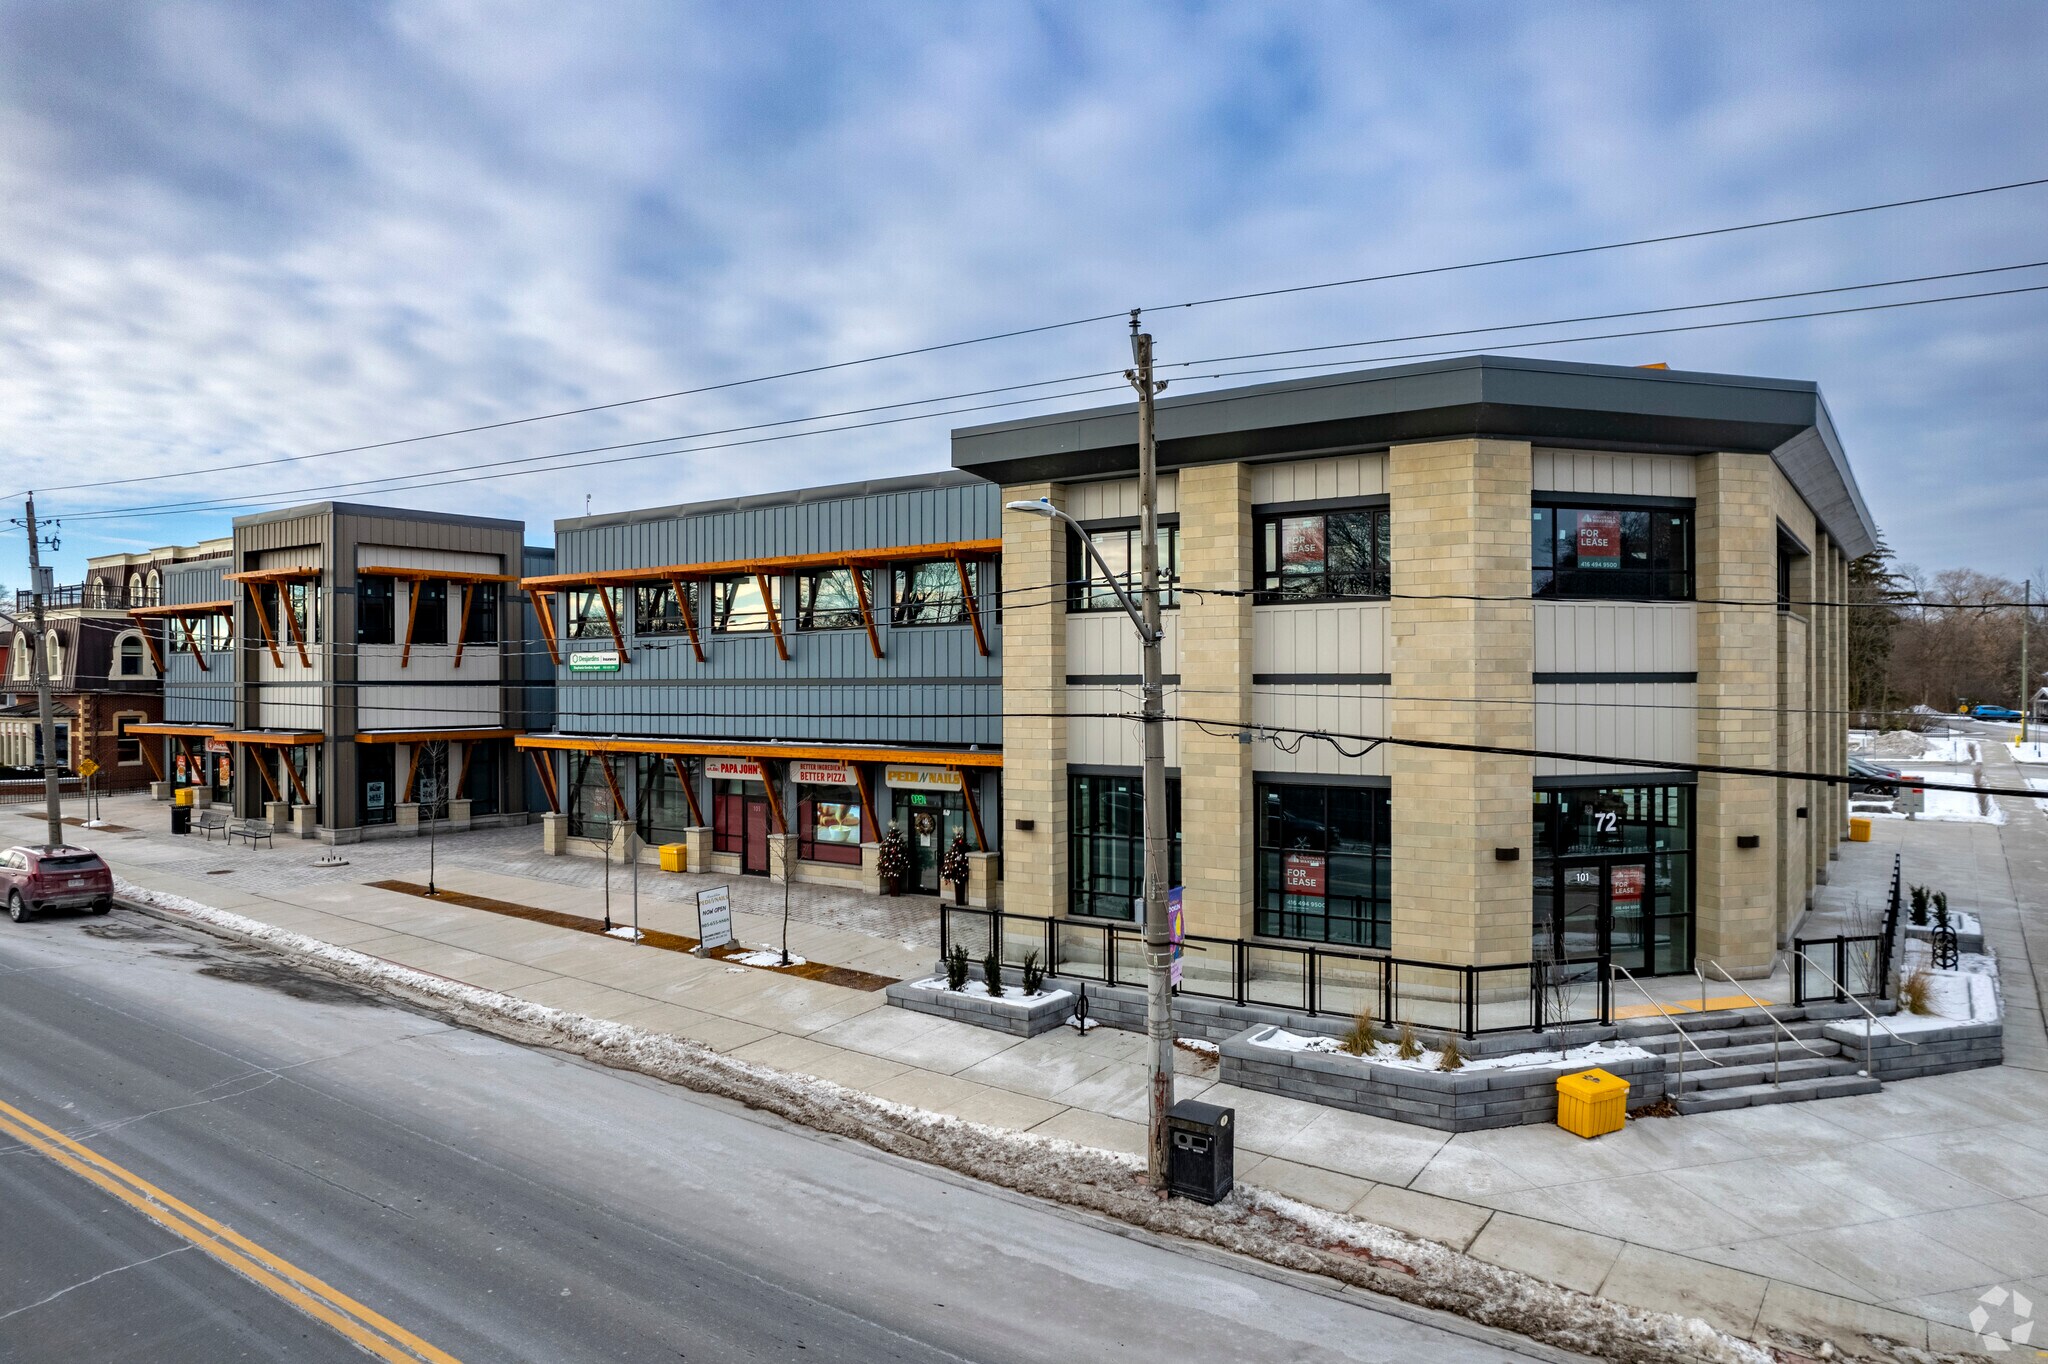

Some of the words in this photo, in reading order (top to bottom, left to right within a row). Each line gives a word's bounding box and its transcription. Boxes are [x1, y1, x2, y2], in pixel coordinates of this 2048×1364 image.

[1580, 529, 1599, 537] FOR
[1581, 538, 1608, 547] LEASE
[720, 763, 738, 774] PAPA
[800, 771, 825, 782] BETTER
[826, 772, 846, 783] PIZZA
[887, 771, 919, 783] PEDI
[919, 772, 929, 783] N
[929, 772, 960, 784] NAILS
[911, 794, 927, 805] OPEN
[1594, 811, 1617, 832] 72
[1287, 868, 1306, 878] FOR
[1576, 873, 1589, 882] 101
[1287, 877, 1316, 887] LEASE
[702, 908, 714, 916] NOW
[714, 905, 727, 914] OPEN
